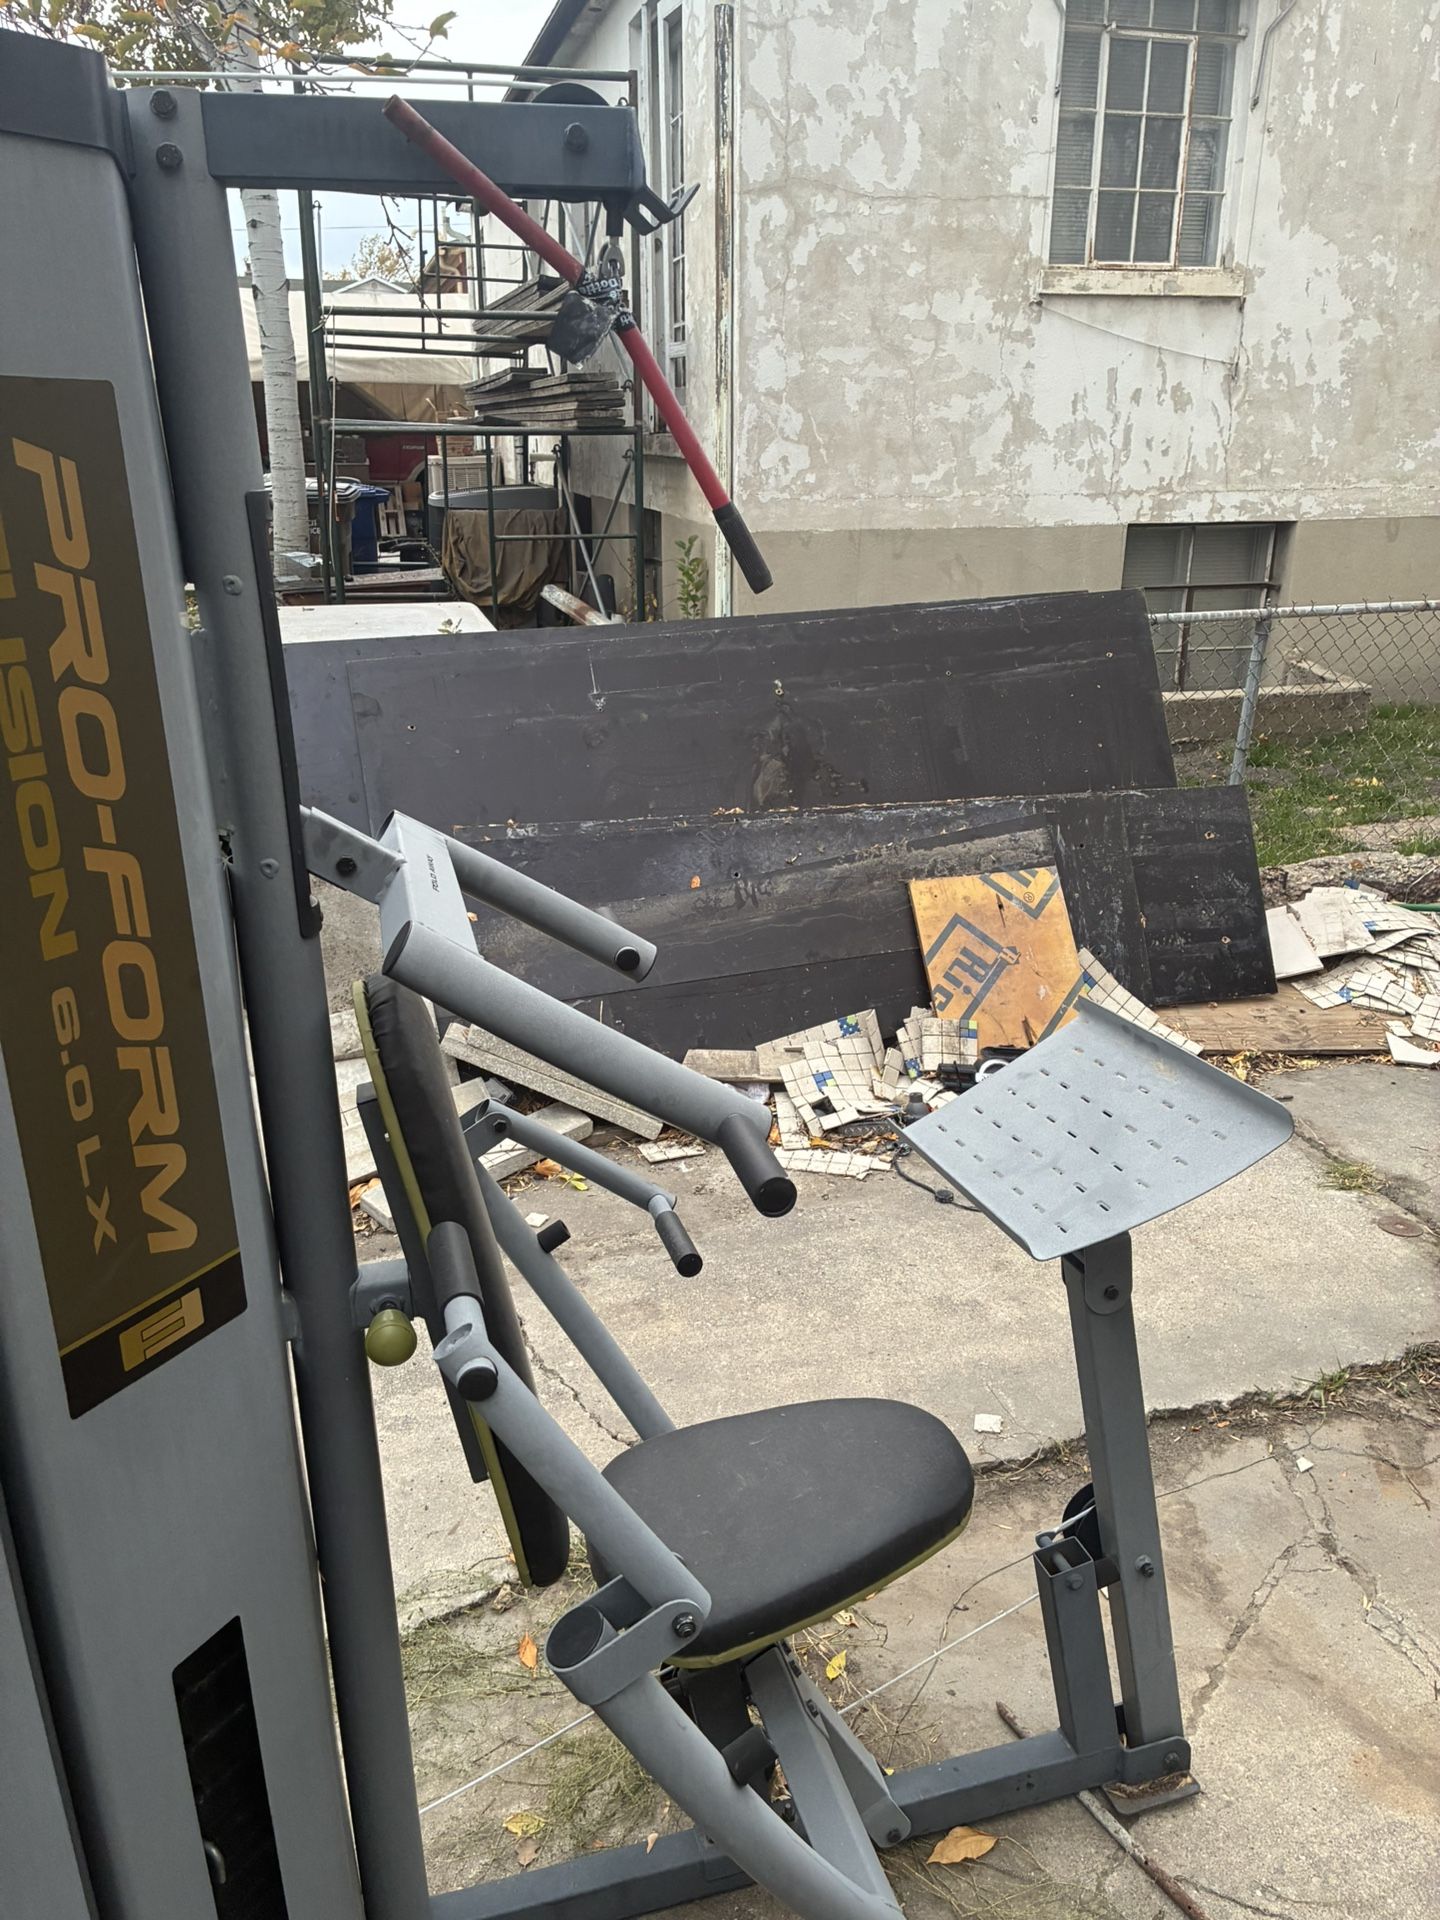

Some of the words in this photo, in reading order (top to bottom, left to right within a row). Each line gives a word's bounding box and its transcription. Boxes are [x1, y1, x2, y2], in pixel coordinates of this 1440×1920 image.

[0, 512, 79, 961] USION
[51, 986, 94, 1122] 6.0
[77, 1134, 117, 1255] LX
[12, 437, 198, 1254] PRO-FORM
[430, 873, 440, 893] FOLD
